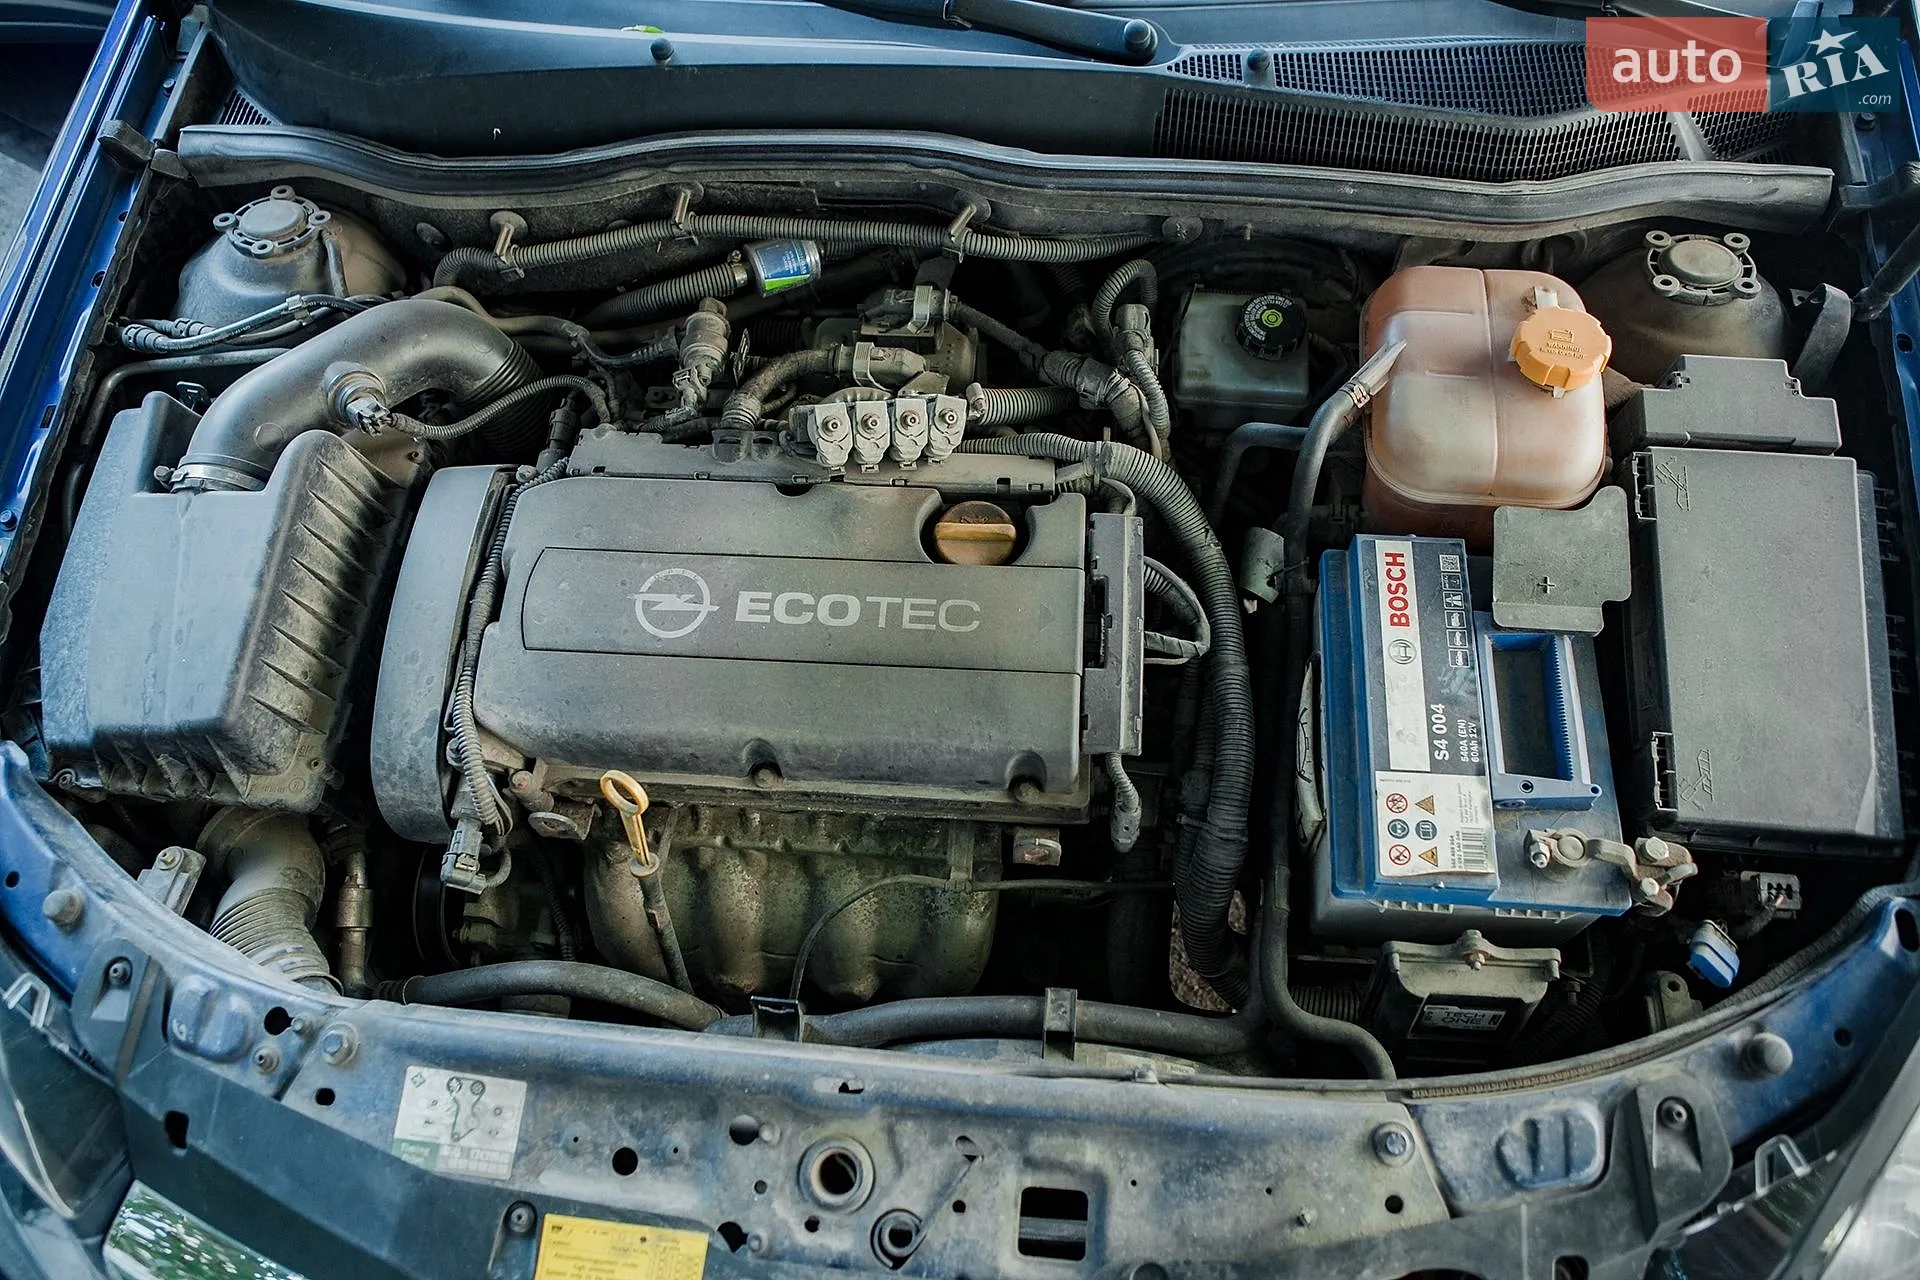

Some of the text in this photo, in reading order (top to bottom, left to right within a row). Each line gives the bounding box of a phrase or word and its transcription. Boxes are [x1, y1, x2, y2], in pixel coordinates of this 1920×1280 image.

[735, 591, 981, 632] ECOTEC
[1384, 552, 1411, 628] BOSCH
[1430, 703, 1449, 761] S4 004
[1456, 719, 1470, 762] 540A (EN)
[1467, 721, 1480, 763] 60Ah 12V
